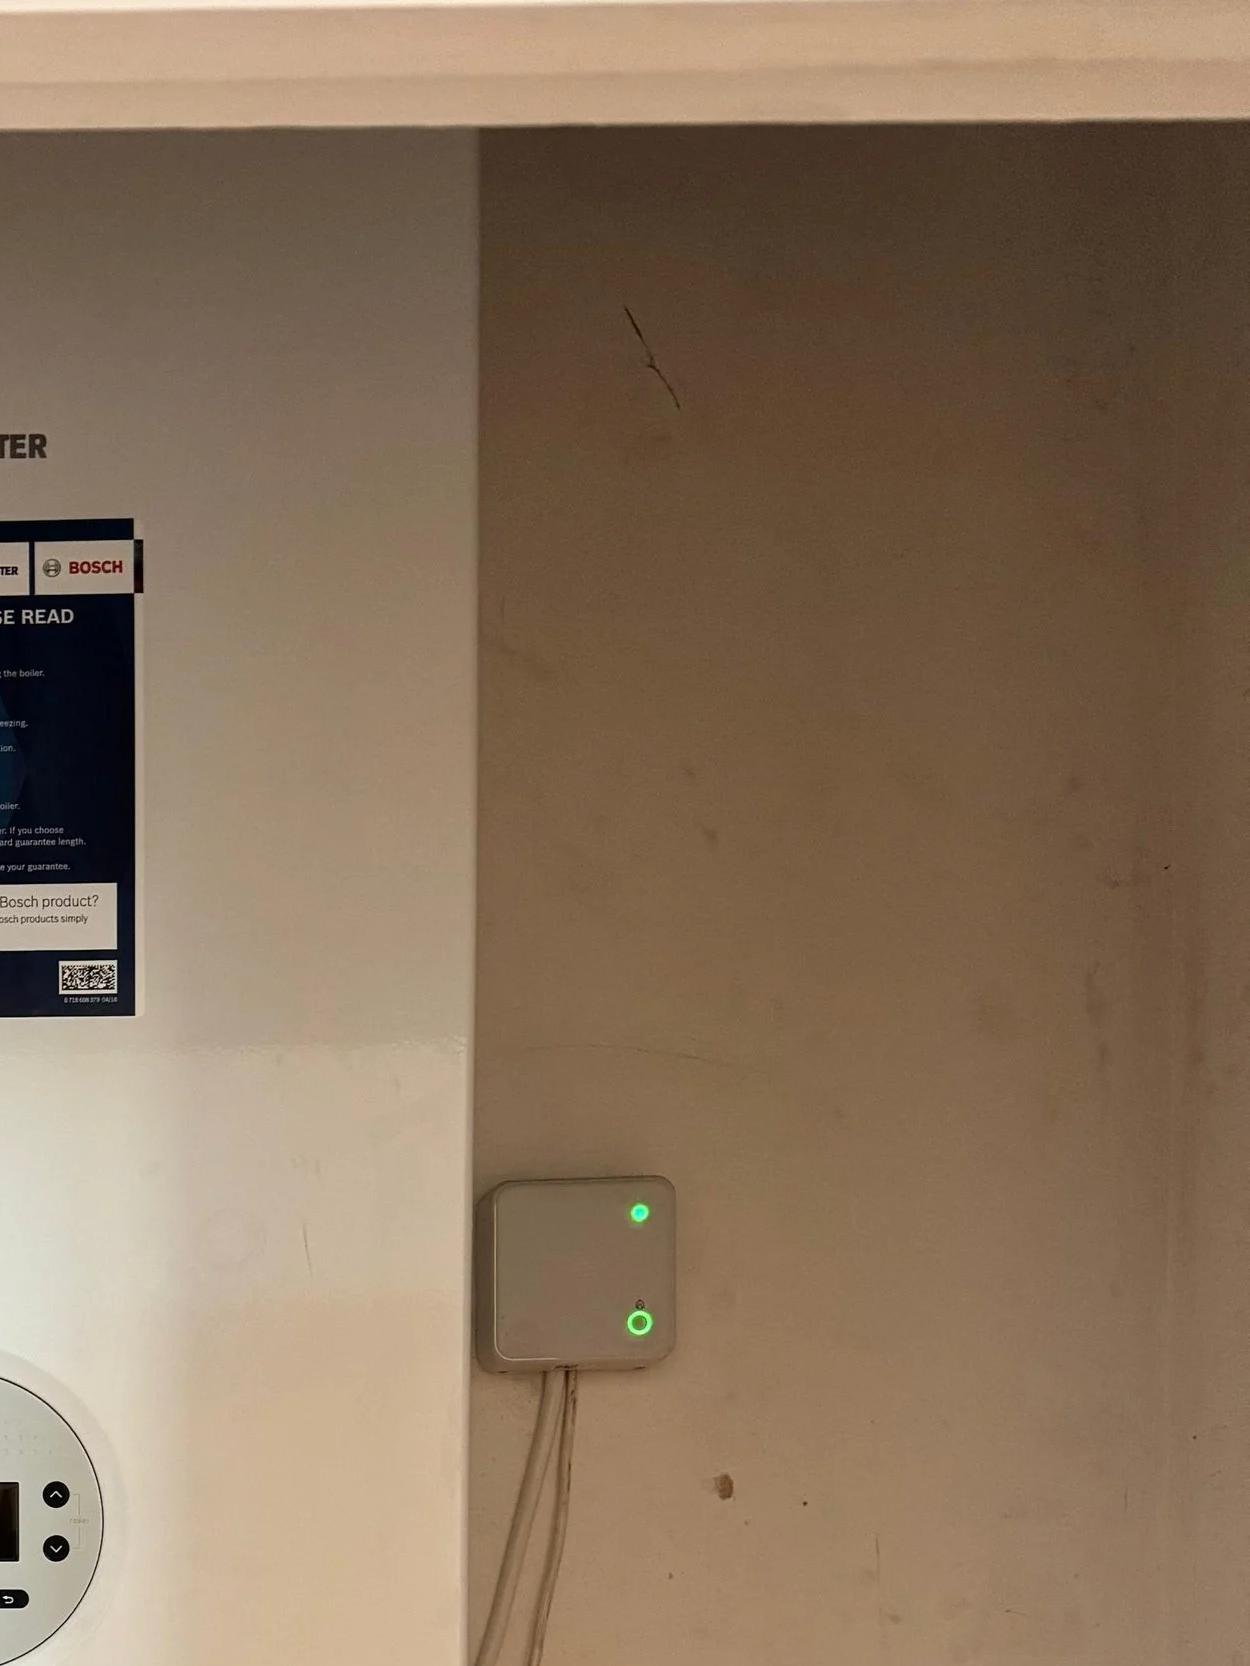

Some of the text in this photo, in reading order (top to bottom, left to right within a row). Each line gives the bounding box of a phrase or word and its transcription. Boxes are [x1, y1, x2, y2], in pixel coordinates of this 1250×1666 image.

[68, 560, 123, 575] BOSCH
[21, 608, 74, 625] READ
[3, 670, 17, 678] the
[19, 669, 45, 677] boiler.
[17, 827, 32, 836] you
[34, 826, 64, 834] choose
[14, 839, 56, 848] guarantee
[58, 838, 86, 847] length.
[7, 865, 25, 873] your
[27, 863, 70, 872] guarantee.
[0, 895, 39, 908] Bosch
[42, 895, 99, 909] product?
[20, 915, 59, 924] products
[60, 914, 88, 924] simply
